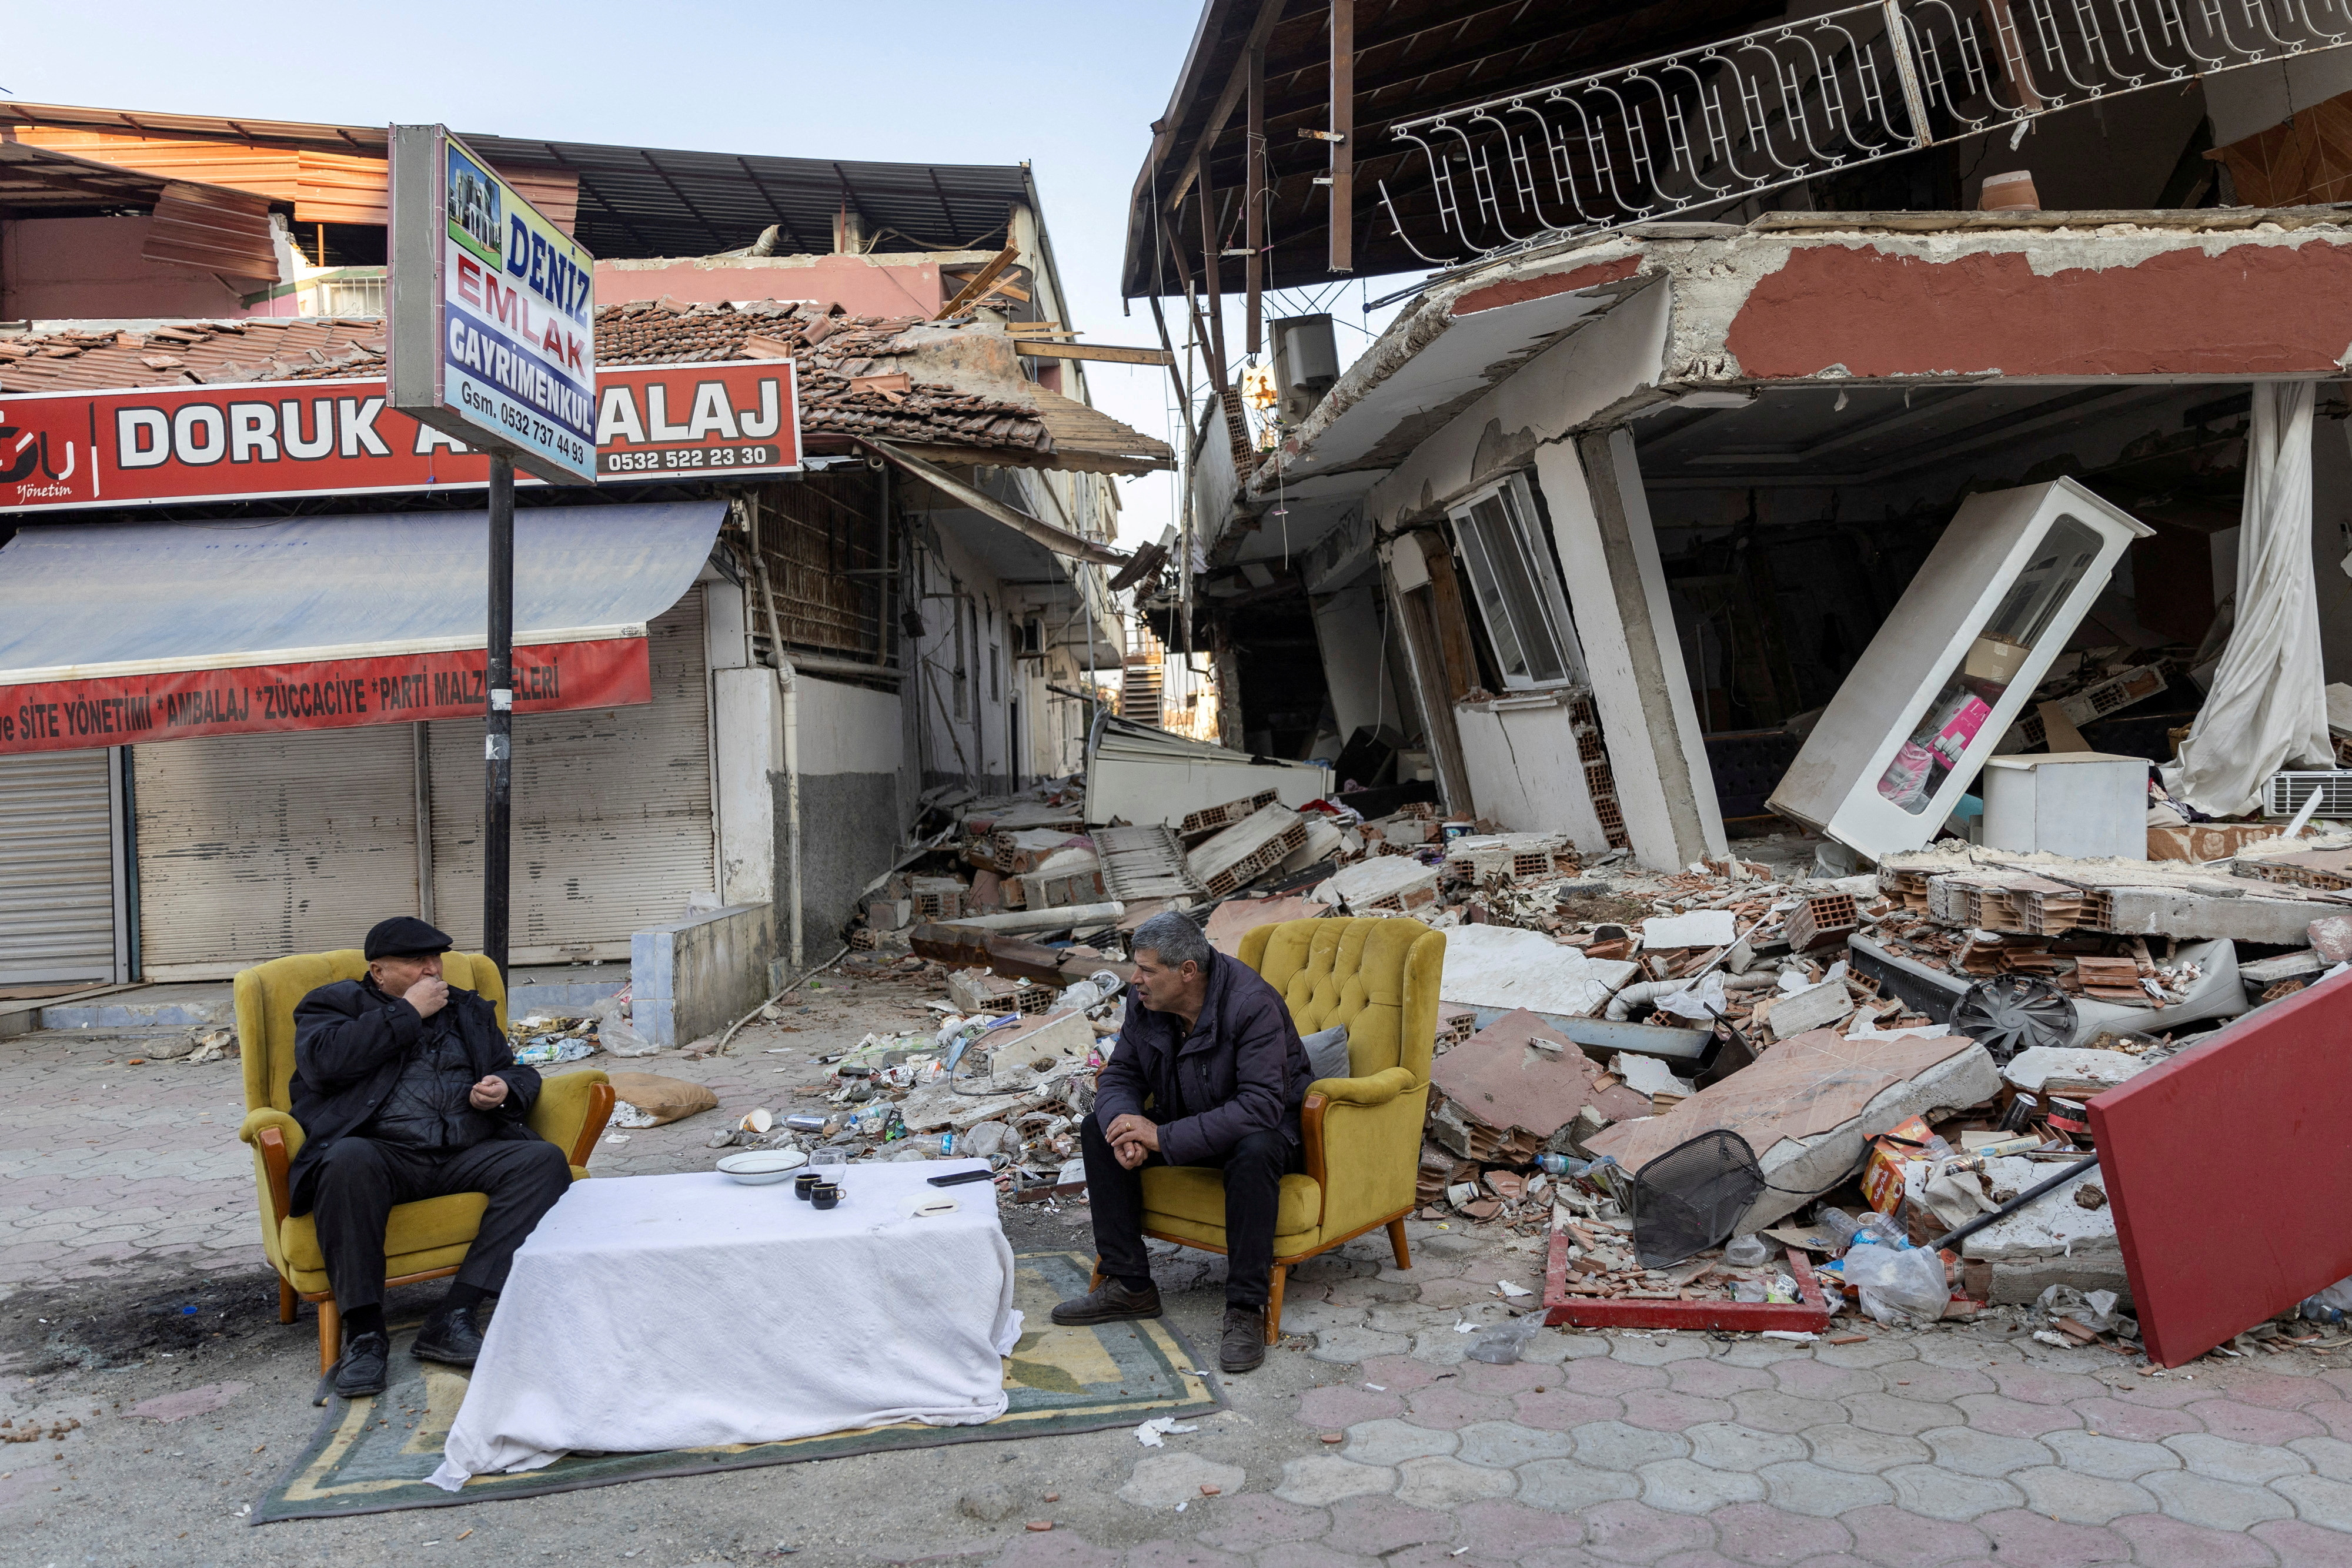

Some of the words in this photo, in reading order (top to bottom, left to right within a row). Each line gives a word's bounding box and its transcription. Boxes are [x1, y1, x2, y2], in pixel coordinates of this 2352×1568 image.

[507, 212, 590, 329] DENİZ
[457, 253, 586, 379] EMLAK
[450, 317, 592, 436] GAYRİMENKUL
[116, 395, 393, 470] DORUK
[462, 381, 496, 419] Gsm.
[501, 403, 529, 436] 0532
[533, 420, 554, 448] 737
[557, 434, 569, 457] 44
[572, 441, 584, 464] 93
[608, 452, 659, 471] 0532
[666, 449, 703, 468] 522
[710, 448, 734, 466] 23
[741, 447, 766, 464] 30
[16, 482, 72, 504] Yönetim
[0, 716, 15, 741] e
[19, 696, 59, 740] SİTE
[63, 687, 153, 736] YÖNETİMİ
[435, 657, 560, 706] MALZELERİ
